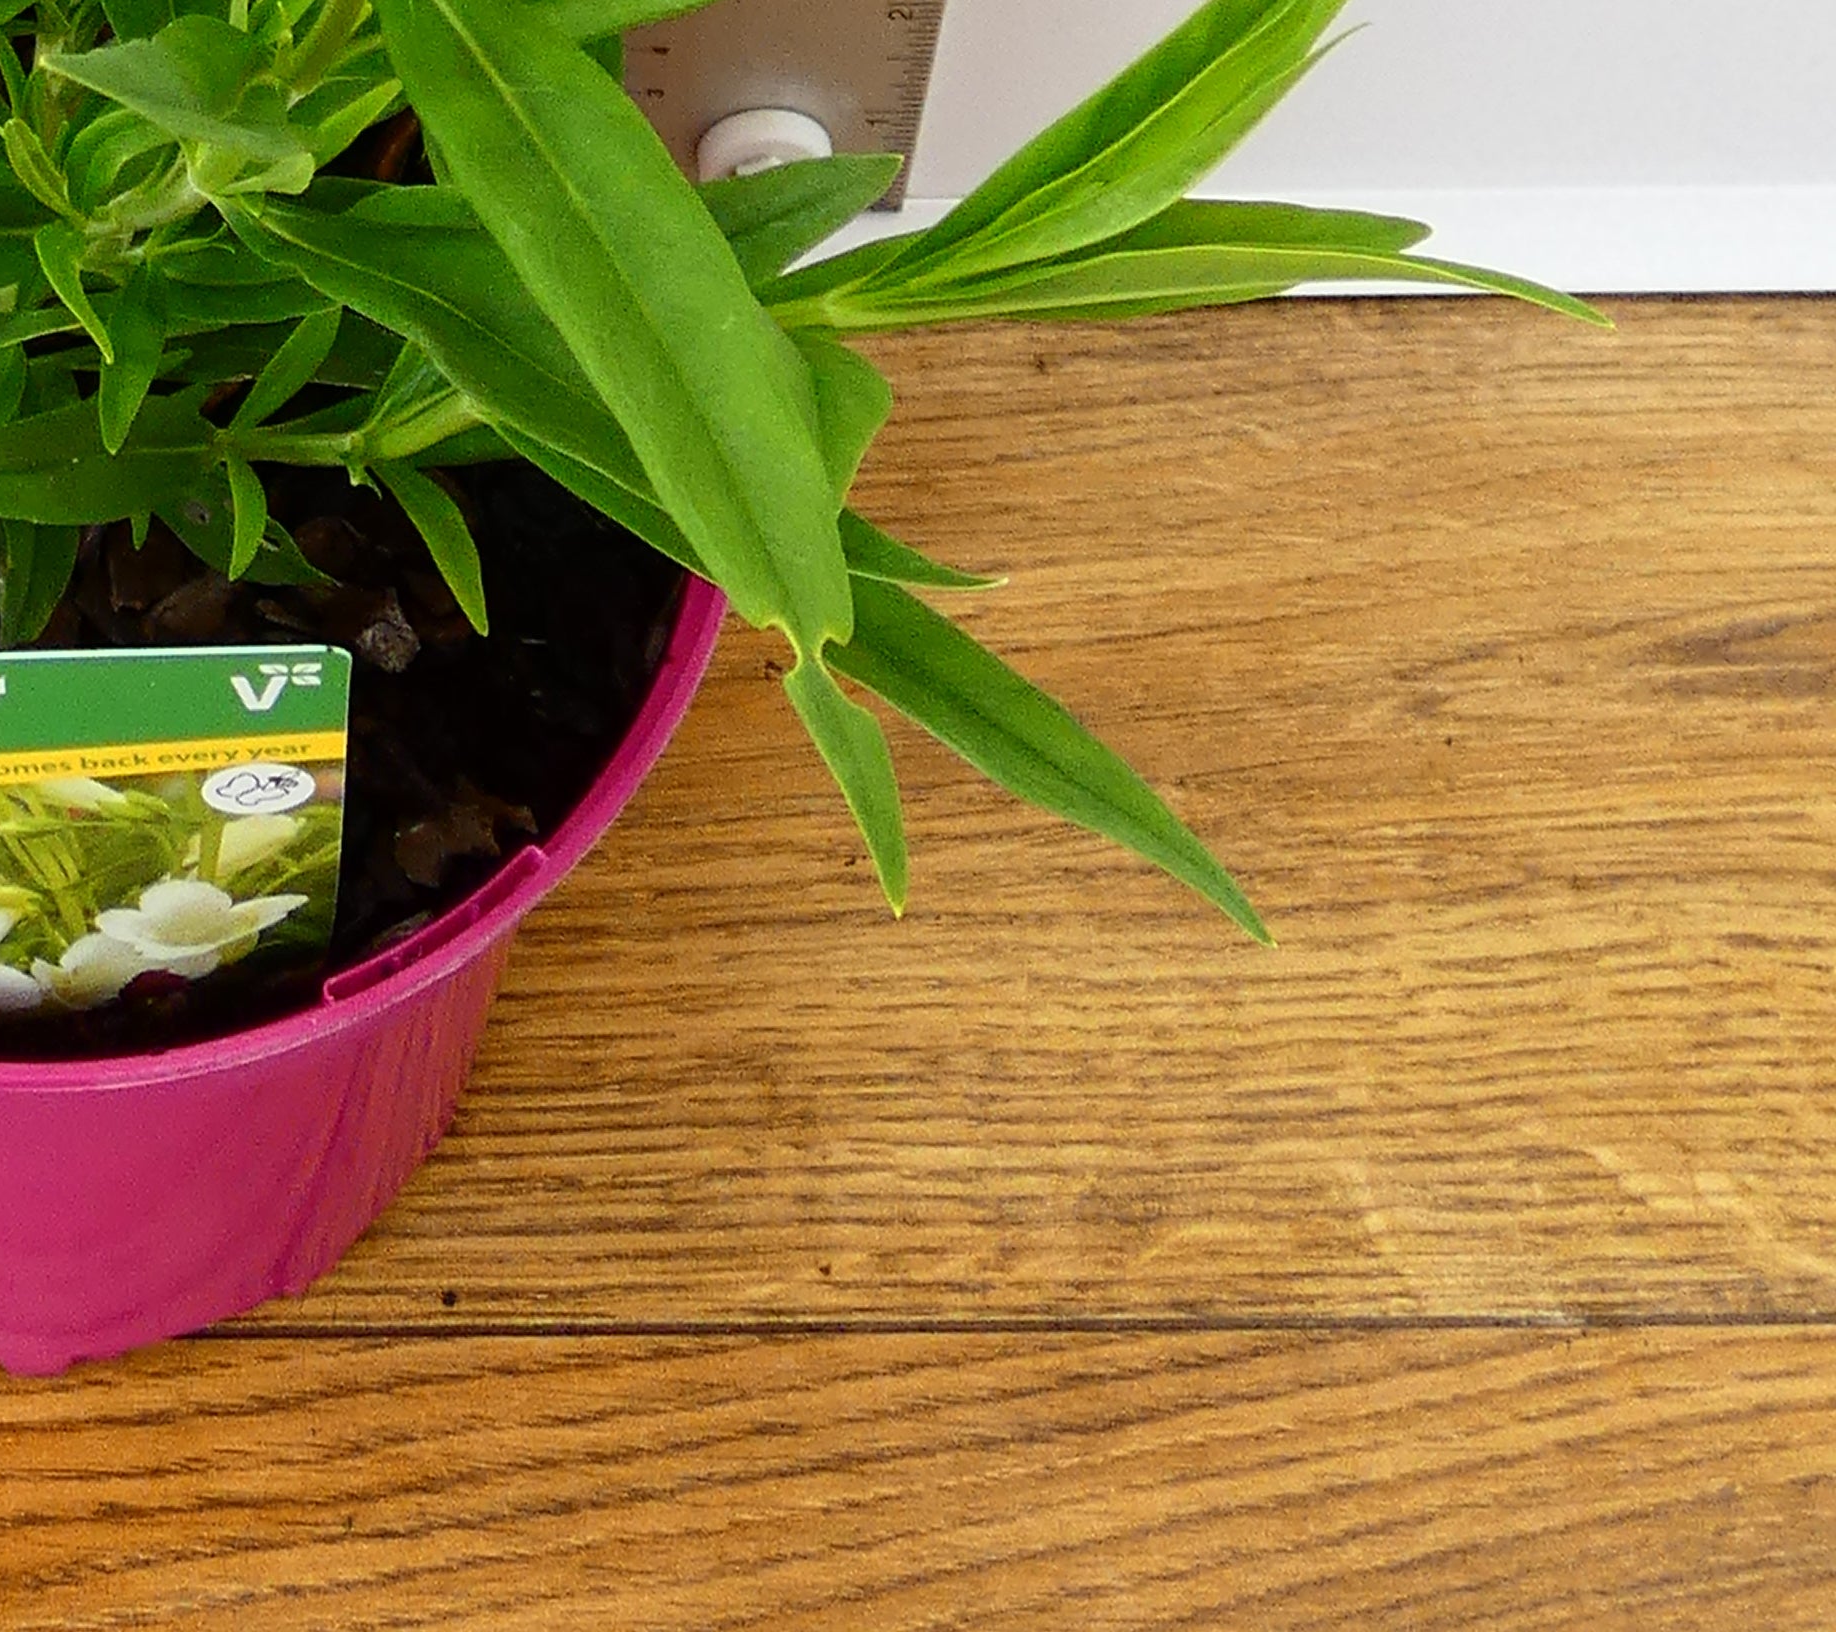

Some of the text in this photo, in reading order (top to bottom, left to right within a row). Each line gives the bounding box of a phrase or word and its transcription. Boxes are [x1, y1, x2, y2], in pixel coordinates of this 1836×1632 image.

[79, 754, 150, 773] back
[161, 748, 239, 765] every
[247, 742, 312, 760] year
